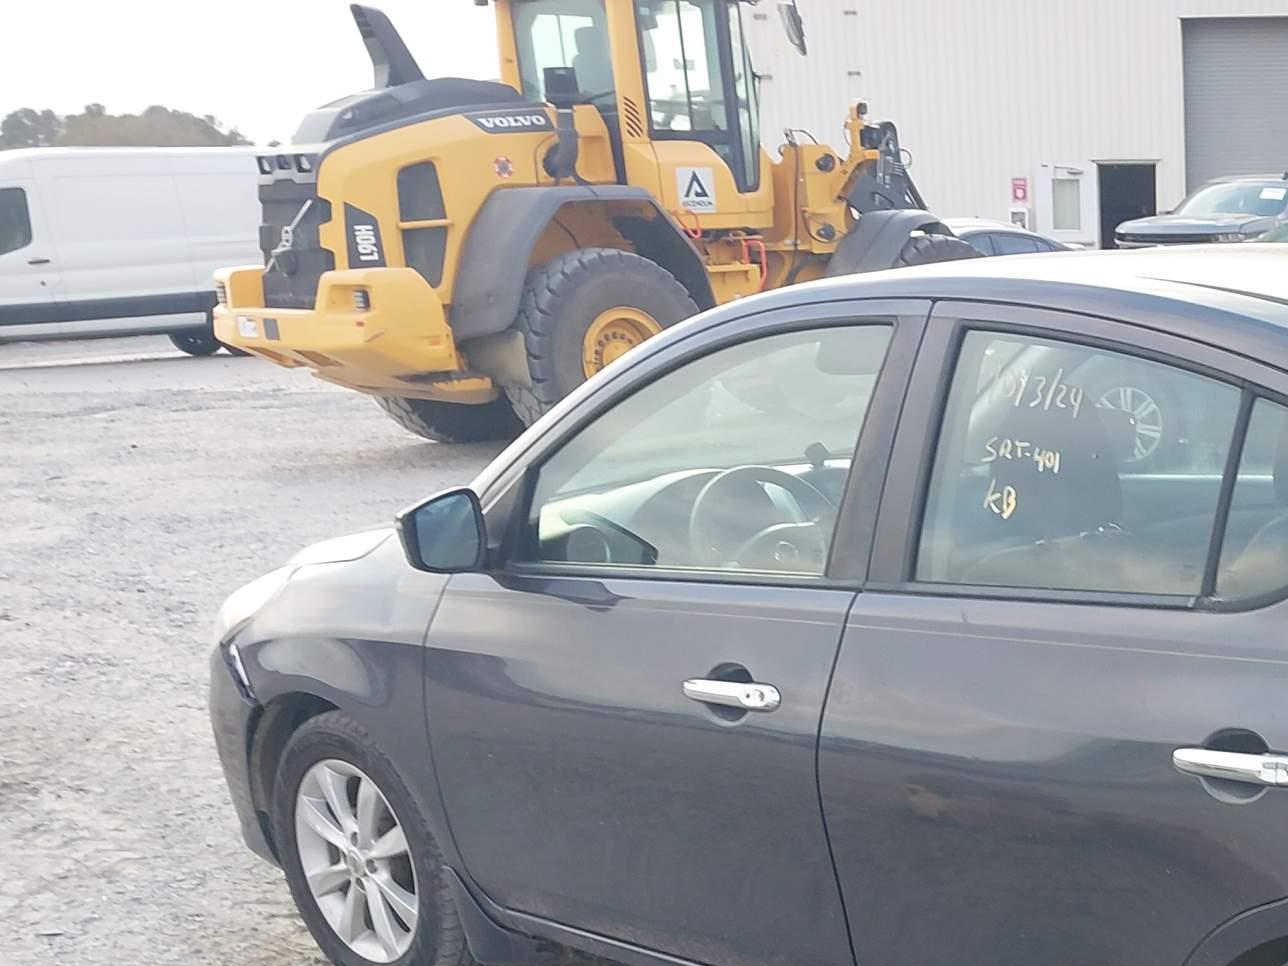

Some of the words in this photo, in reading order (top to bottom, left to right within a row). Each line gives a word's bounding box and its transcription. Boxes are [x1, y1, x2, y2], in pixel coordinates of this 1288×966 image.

[476, 115, 546, 128] VOLVO
[353, 225, 379, 261] L90H
[981, 437, 1060, 473] SRT-401
